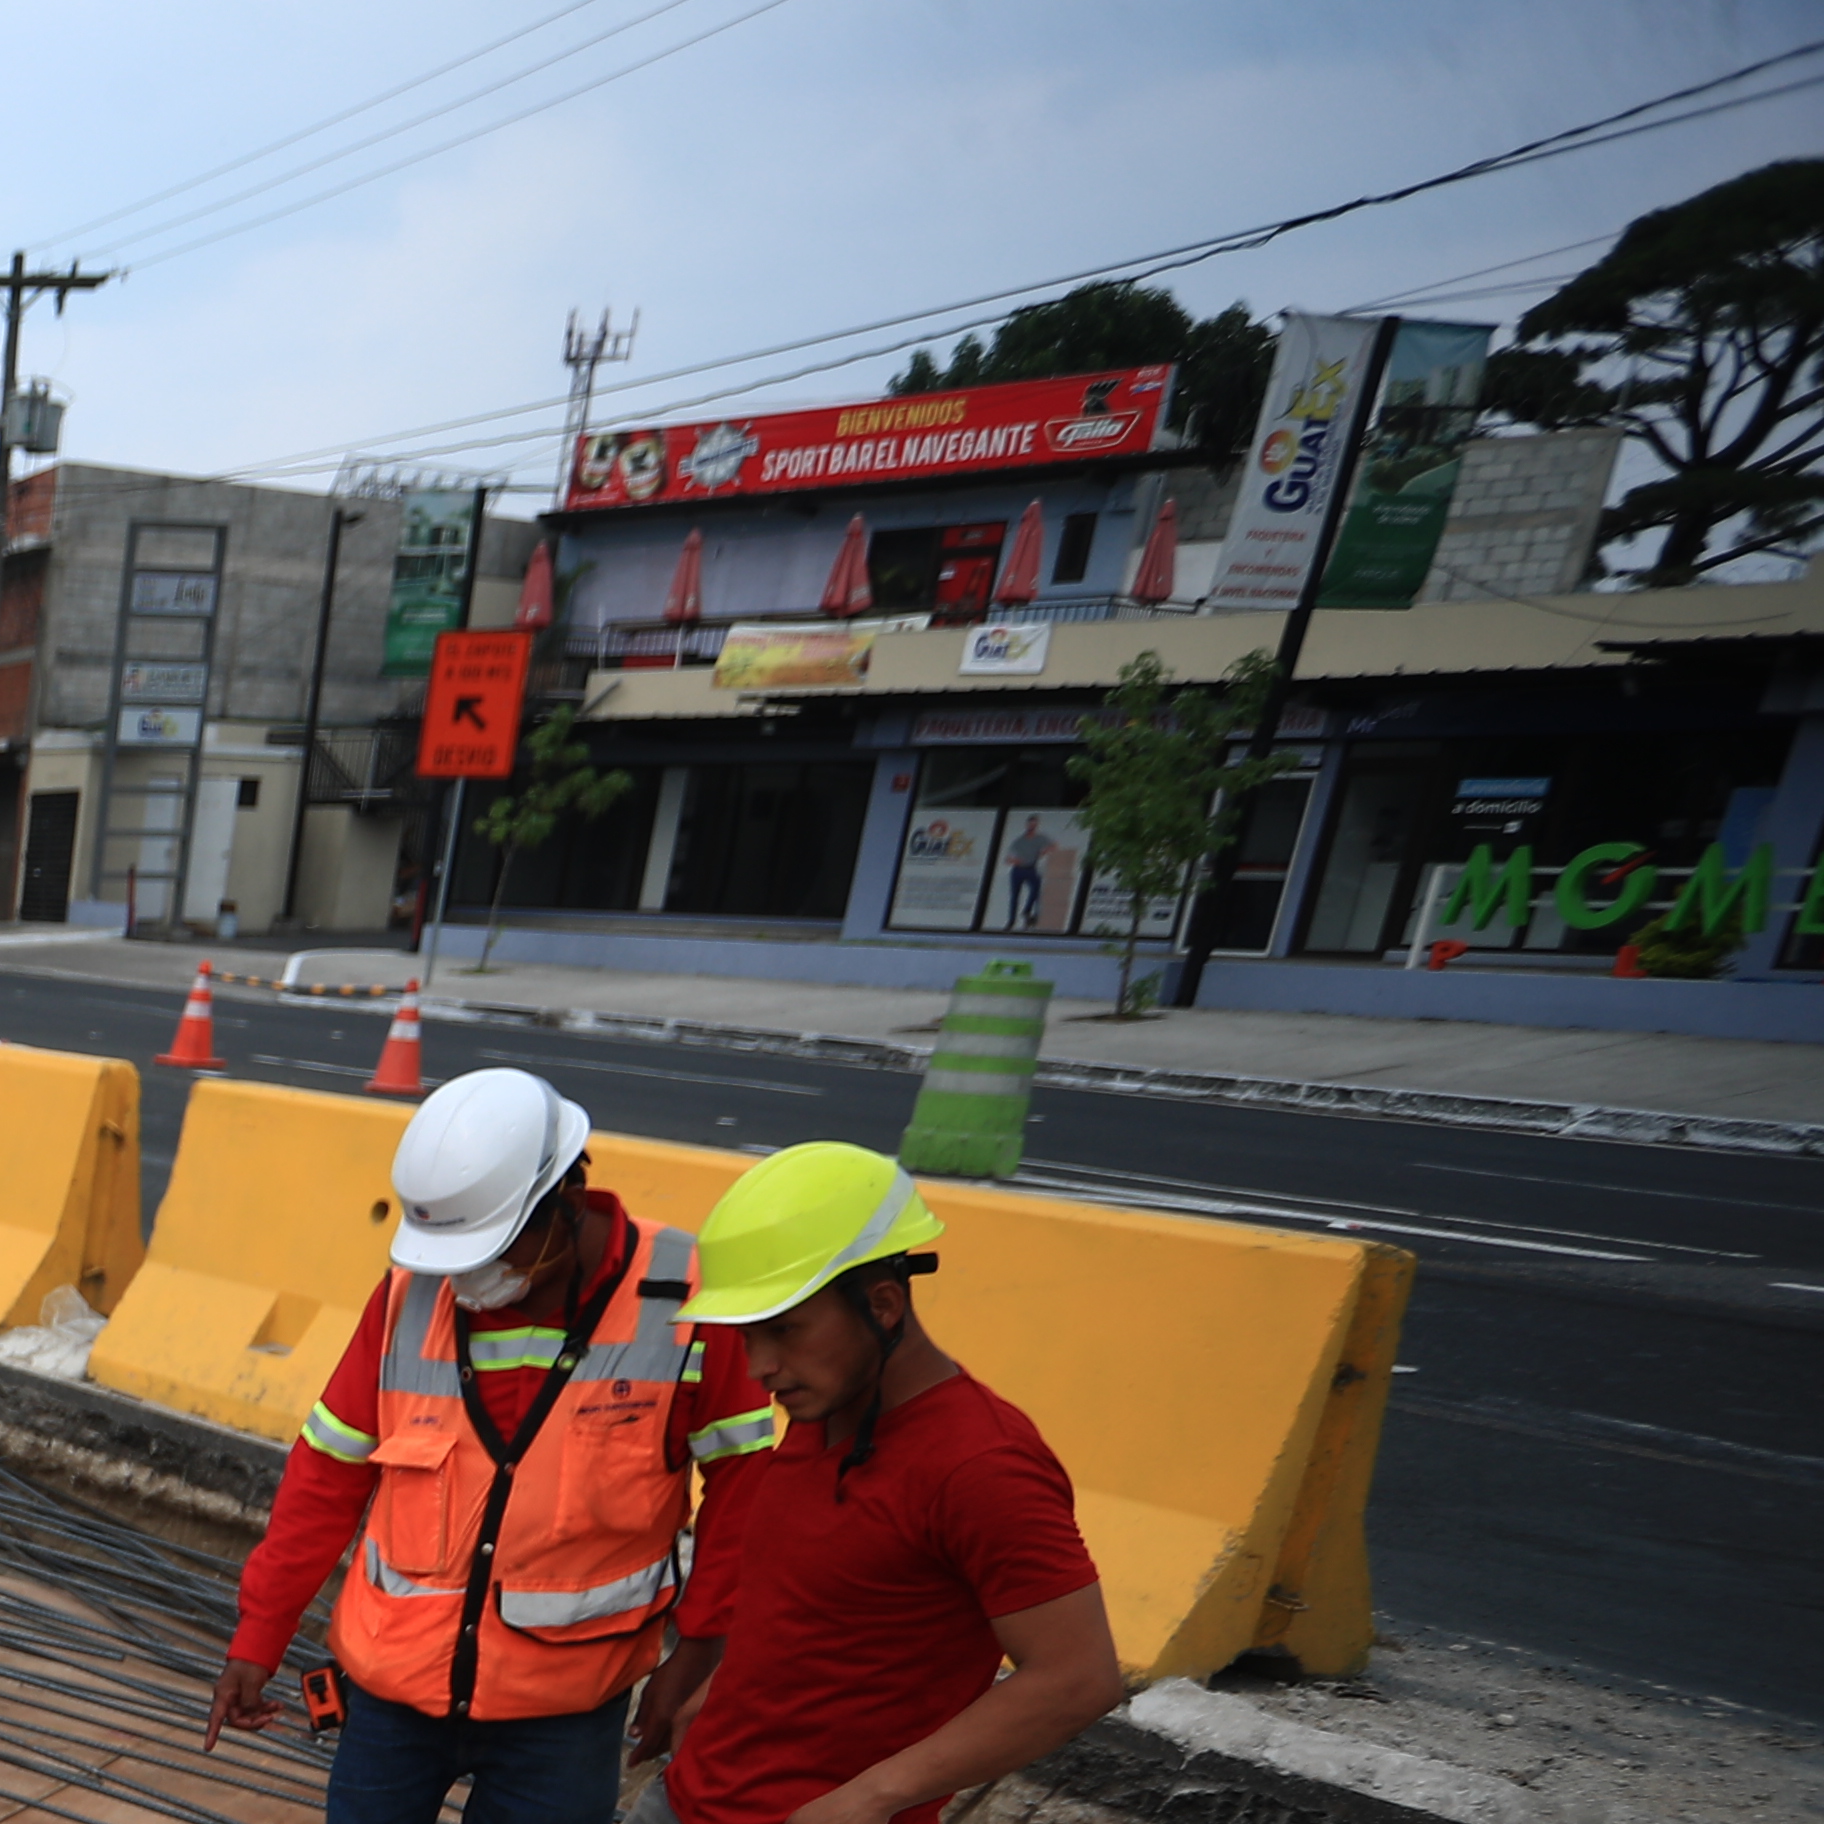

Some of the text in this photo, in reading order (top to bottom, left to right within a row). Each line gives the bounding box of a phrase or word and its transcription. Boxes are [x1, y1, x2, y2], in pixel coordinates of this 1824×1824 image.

[837, 398, 967, 437] BIENVENIDOS
[761, 446, 830, 482] SPORT
[830, 442, 878, 475] BAR
[874, 438, 900, 470] EL
[902, 422, 1038, 467] NAVEGANTE
[1465, 798, 1543, 815] domicilio
